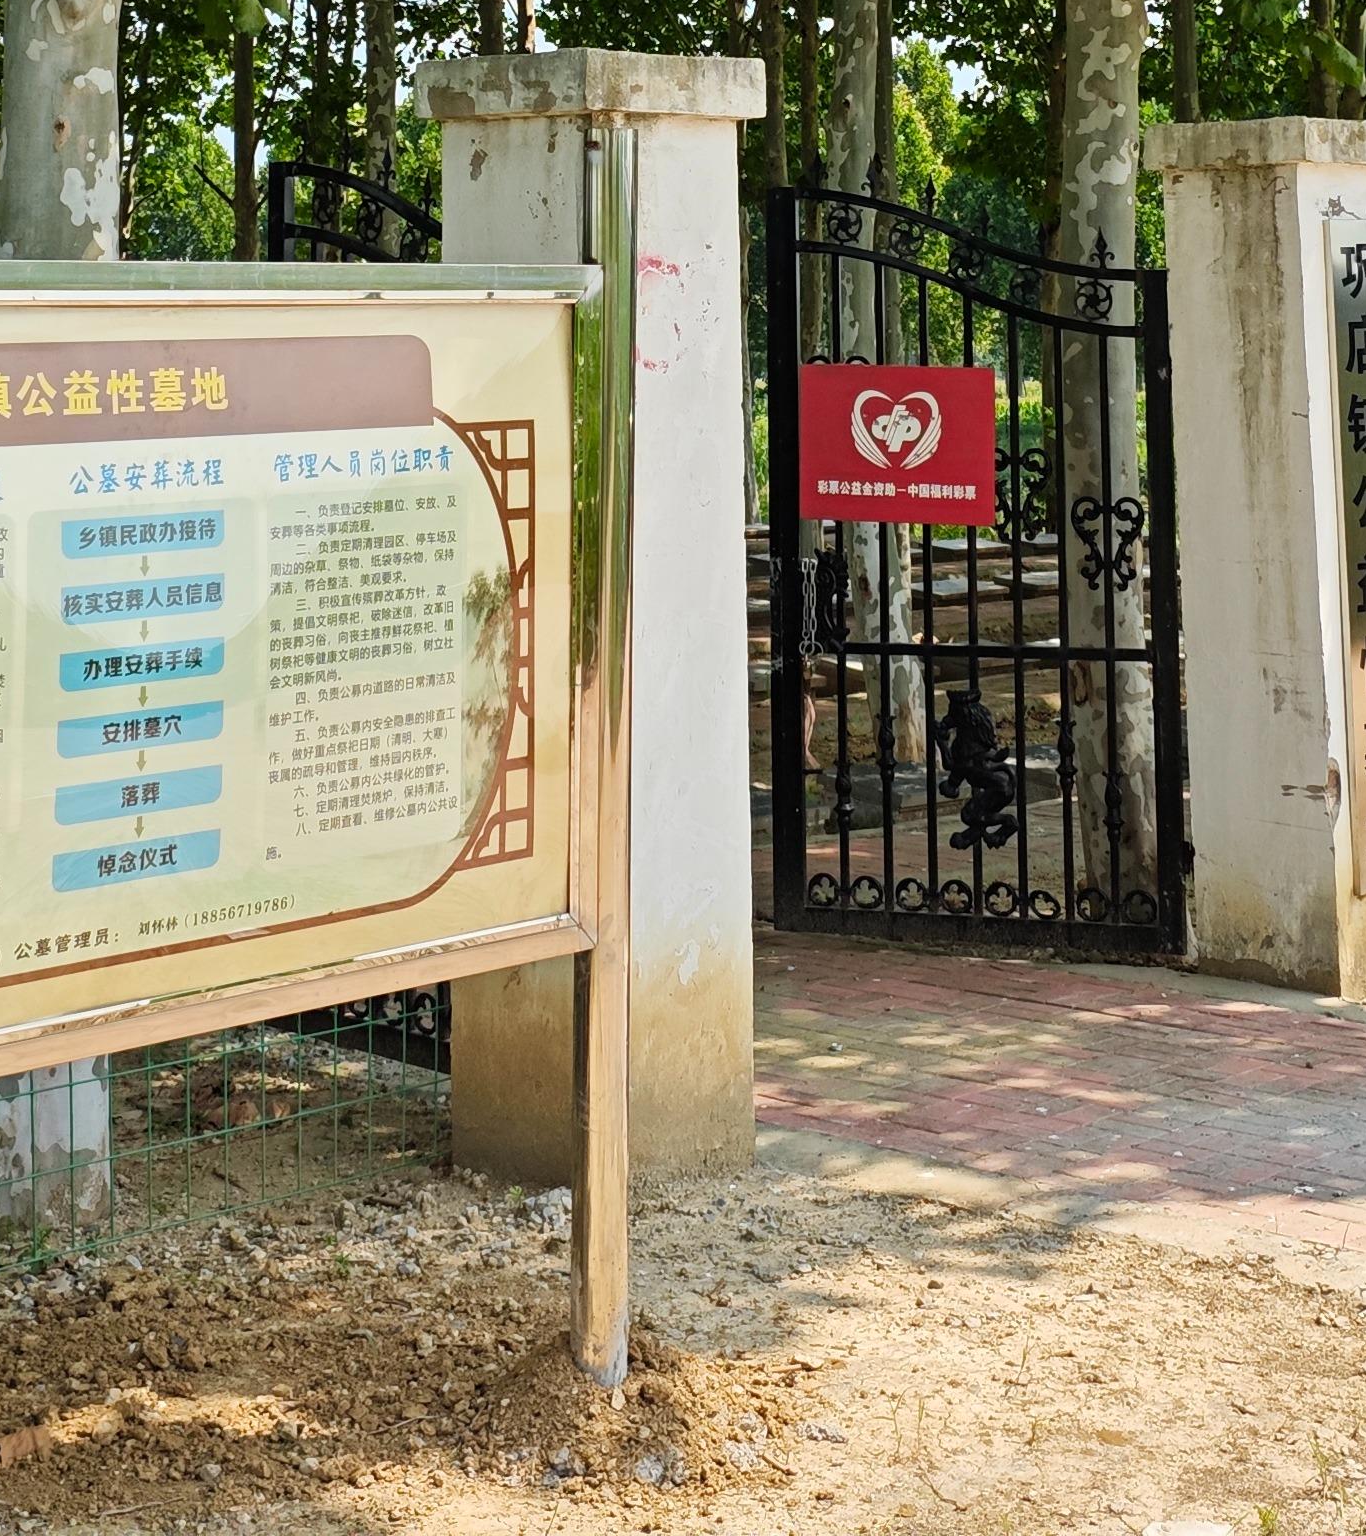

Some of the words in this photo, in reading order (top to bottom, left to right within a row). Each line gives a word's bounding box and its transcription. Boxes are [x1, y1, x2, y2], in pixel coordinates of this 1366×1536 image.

[69, 459, 224, 495] 公墓安葬流程
[274, 445, 453, 482] 管理人员岗位职责
[78, 517, 216, 549] 乡镇民政办接待
[64, 581, 222, 618] 核实安葬人员信息
[83, 647, 203, 681] 办理安葬手续
[102, 714, 182, 744] 安排墓穴
[121, 782, 160, 808] 落葬
[97, 844, 177, 877] 悼念仪式
